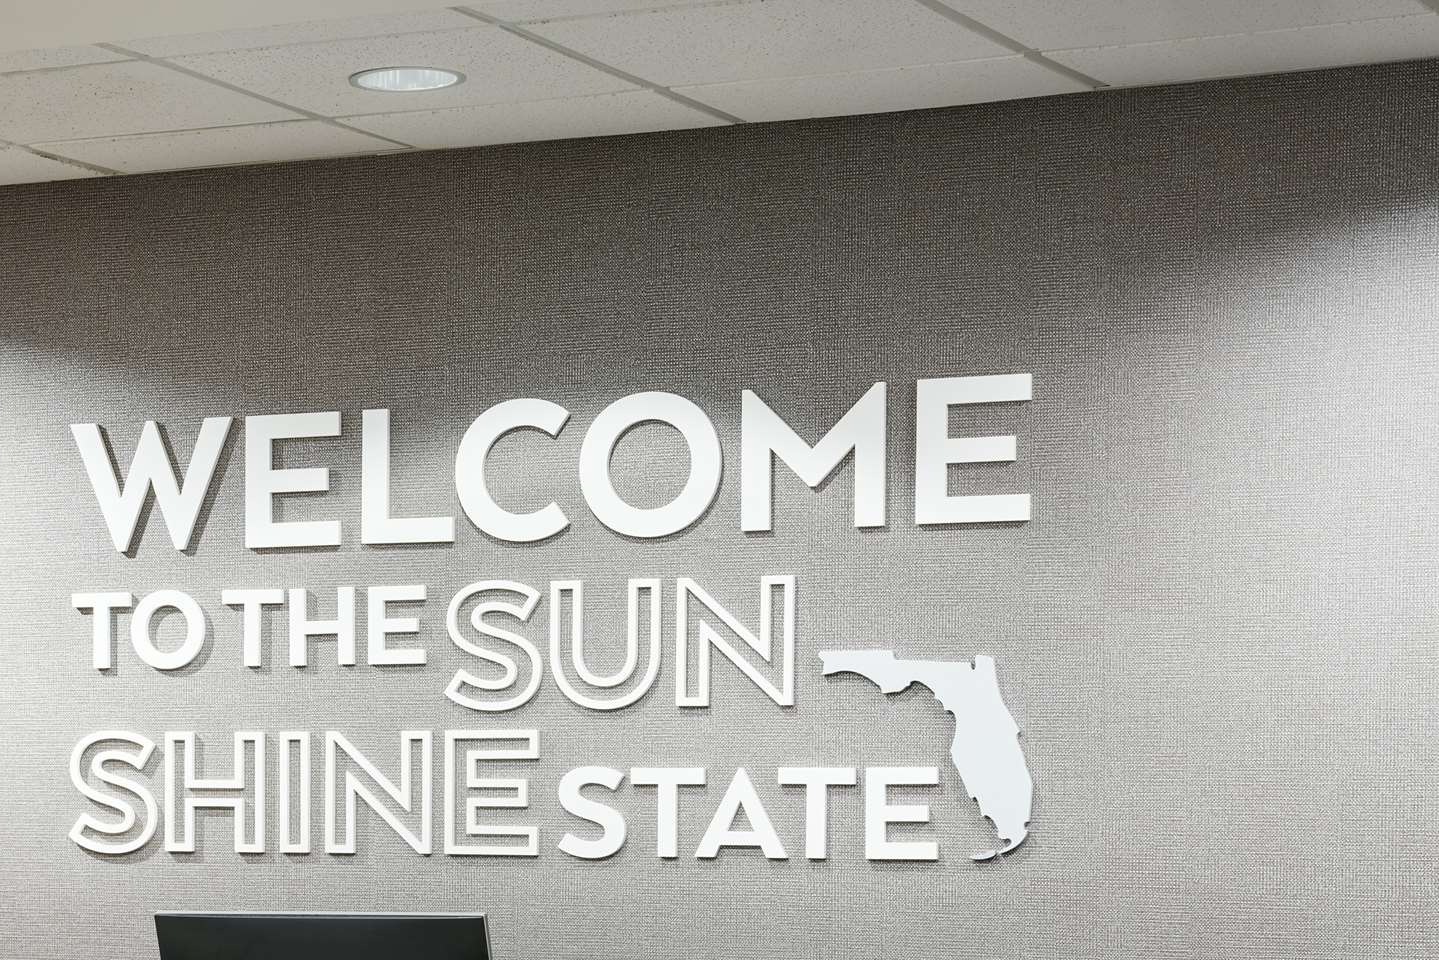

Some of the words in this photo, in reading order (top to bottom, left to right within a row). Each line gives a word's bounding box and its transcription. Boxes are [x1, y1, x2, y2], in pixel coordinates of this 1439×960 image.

[70, 373, 1032, 554] WELCOME
[71, 591, 204, 670] TO
[222, 584, 428, 667] THE
[444, 574, 796, 712] SUN
[68, 729, 540, 857] SHINE
[558, 765, 940, 861] STATE
